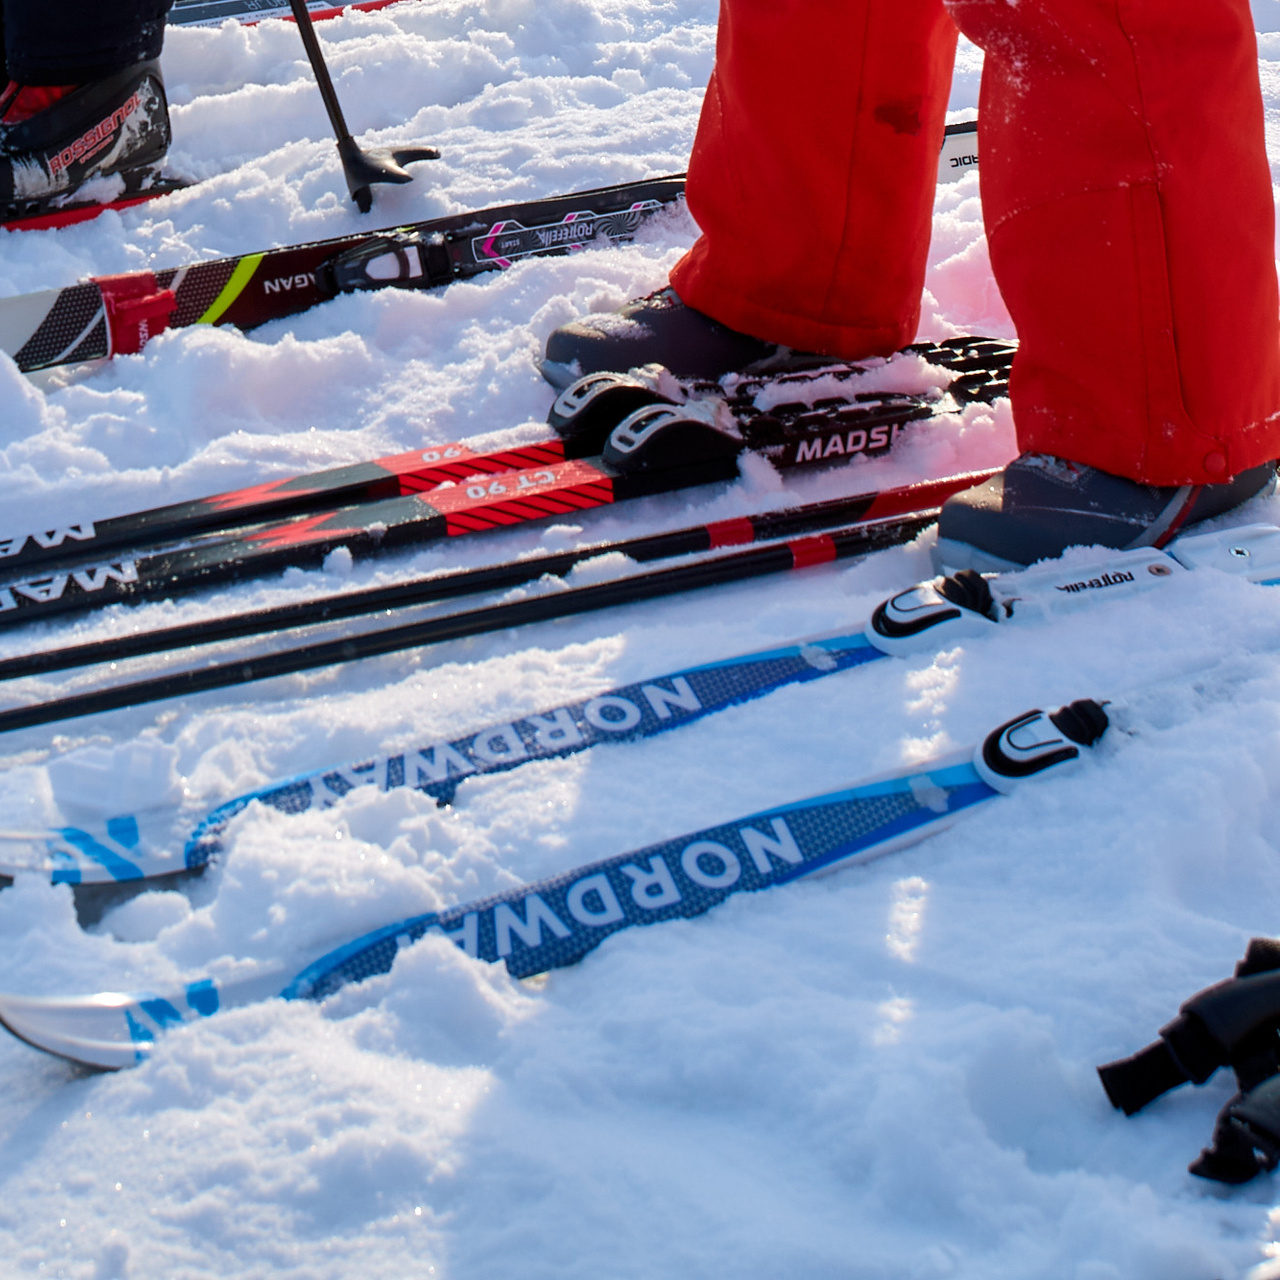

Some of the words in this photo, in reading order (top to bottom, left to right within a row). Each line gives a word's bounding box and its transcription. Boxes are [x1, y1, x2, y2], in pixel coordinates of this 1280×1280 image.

[49, 91, 142, 176] ROSSIGNOL
[465, 481, 507, 500] 90
[516, 470, 556, 491] CT
[420, 815, 805, 960] NORDWA
